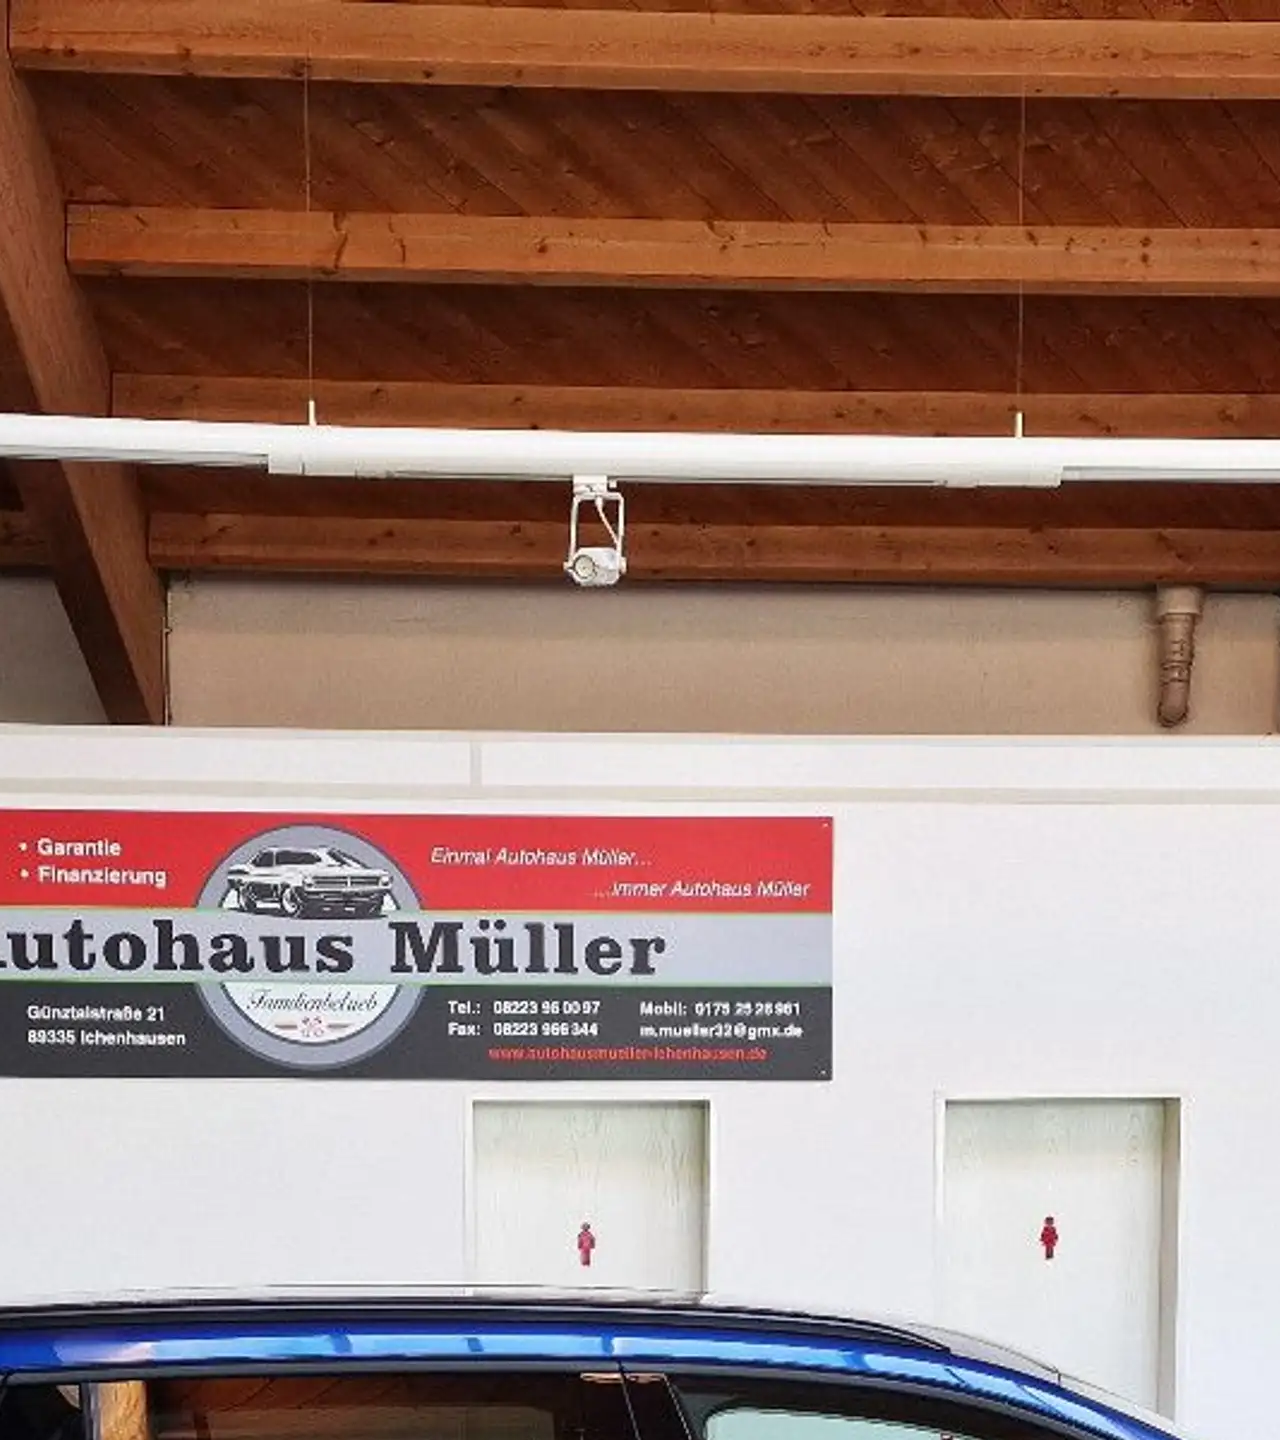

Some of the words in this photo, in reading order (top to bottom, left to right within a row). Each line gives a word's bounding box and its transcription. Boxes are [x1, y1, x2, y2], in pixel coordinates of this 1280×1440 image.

[37, 838, 122, 857] Garantie
[431, 847, 490, 865] Einmal
[495, 847, 577, 867] Autohaus
[38, 865, 167, 889] Finanzierung
[670, 879, 753, 899] Autohaus
[757, 879, 811, 899] Müller
[389, 918, 666, 976] Müller
[27, 1005, 142, 1021] Günztalstraße
[146, 1006, 165, 1022] 21
[448, 1000, 481, 1015] Tel.:
[493, 1000, 538, 1015] 08223
[639, 1000, 687, 1017] Mobil:
[27, 1029, 76, 1044] 89335
[80, 1029, 186, 1046] Ichenhausen
[448, 1022, 481, 1036] Fax:
[493, 1022, 538, 1036] 08223
